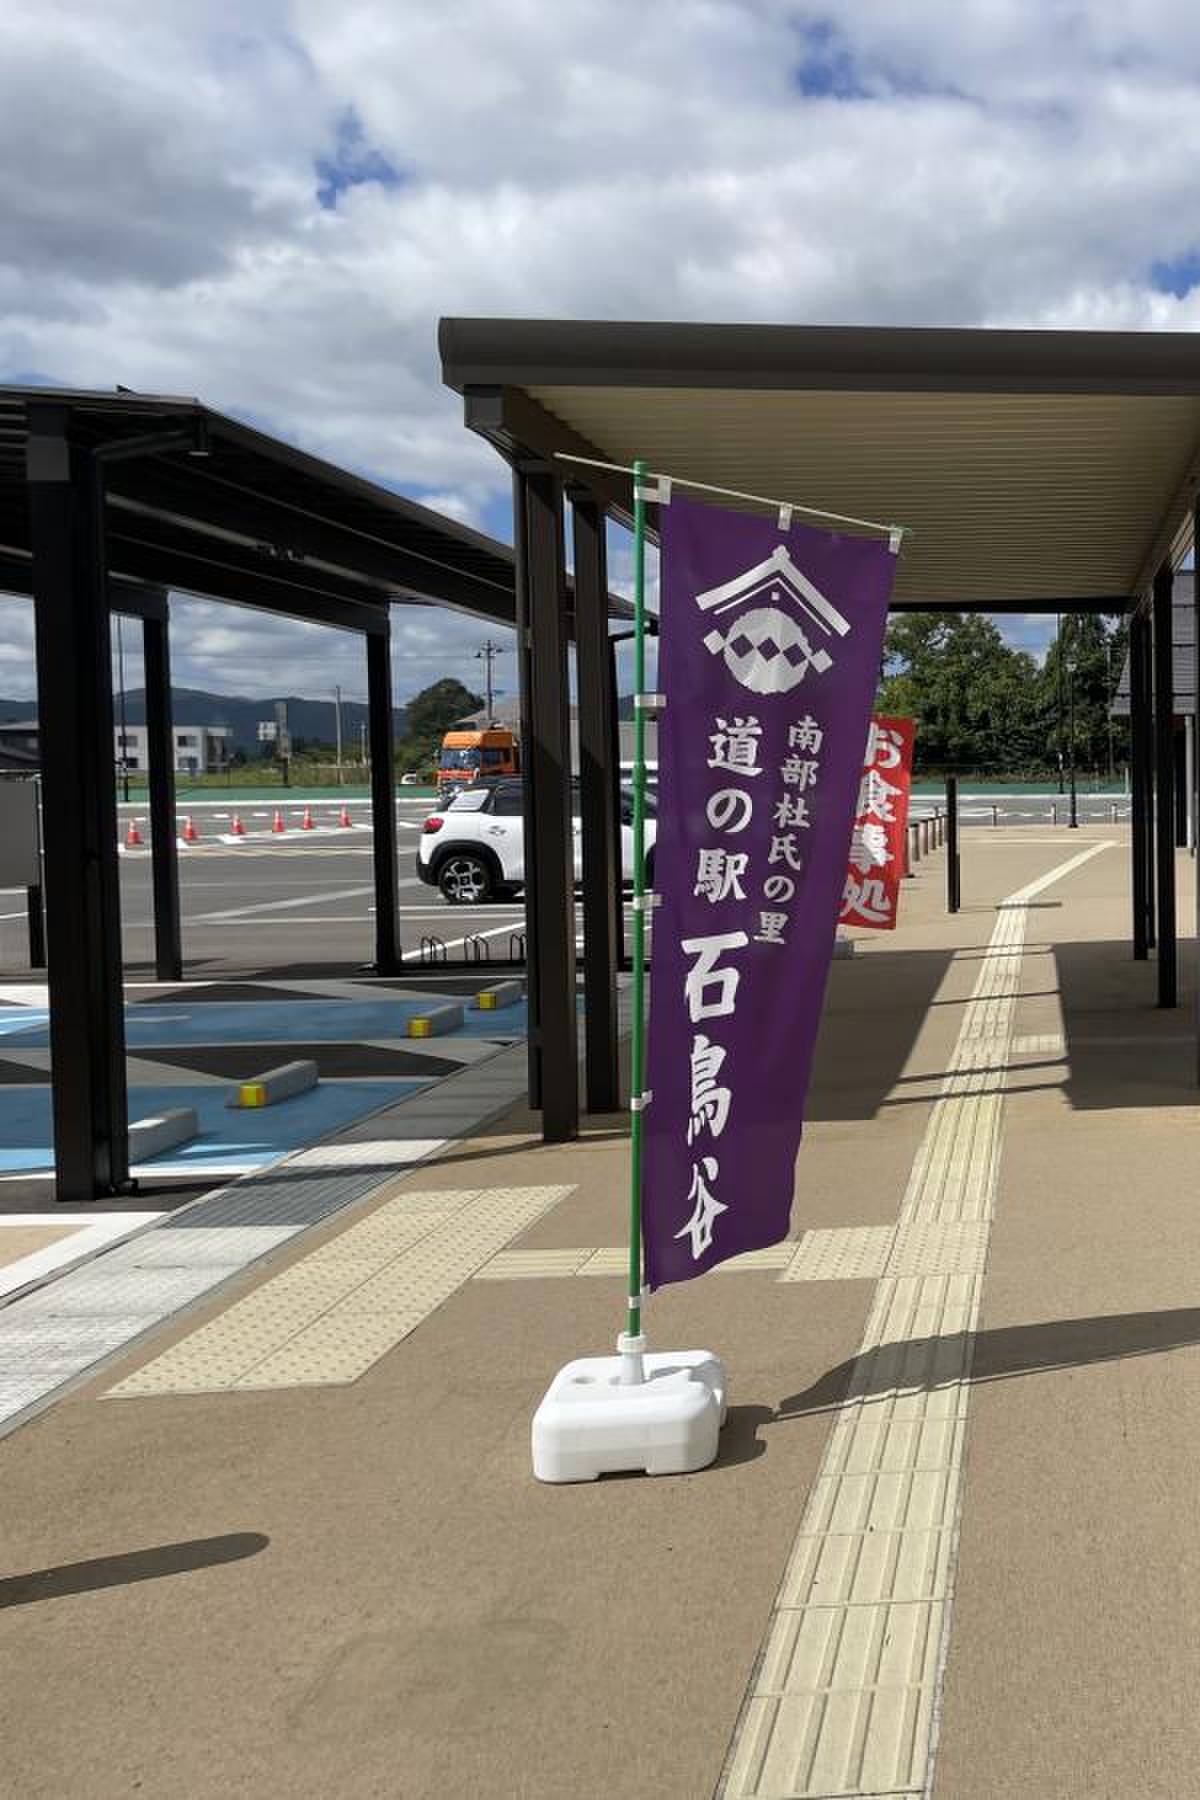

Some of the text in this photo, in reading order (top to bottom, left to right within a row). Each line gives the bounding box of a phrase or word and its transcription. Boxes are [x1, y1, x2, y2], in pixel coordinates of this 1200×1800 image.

[753, 715, 824, 944] 南部杜氏の里
[840, 721, 903, 923] お食事処
[673, 716, 763, 1260] 道の駅 石鳥谷
